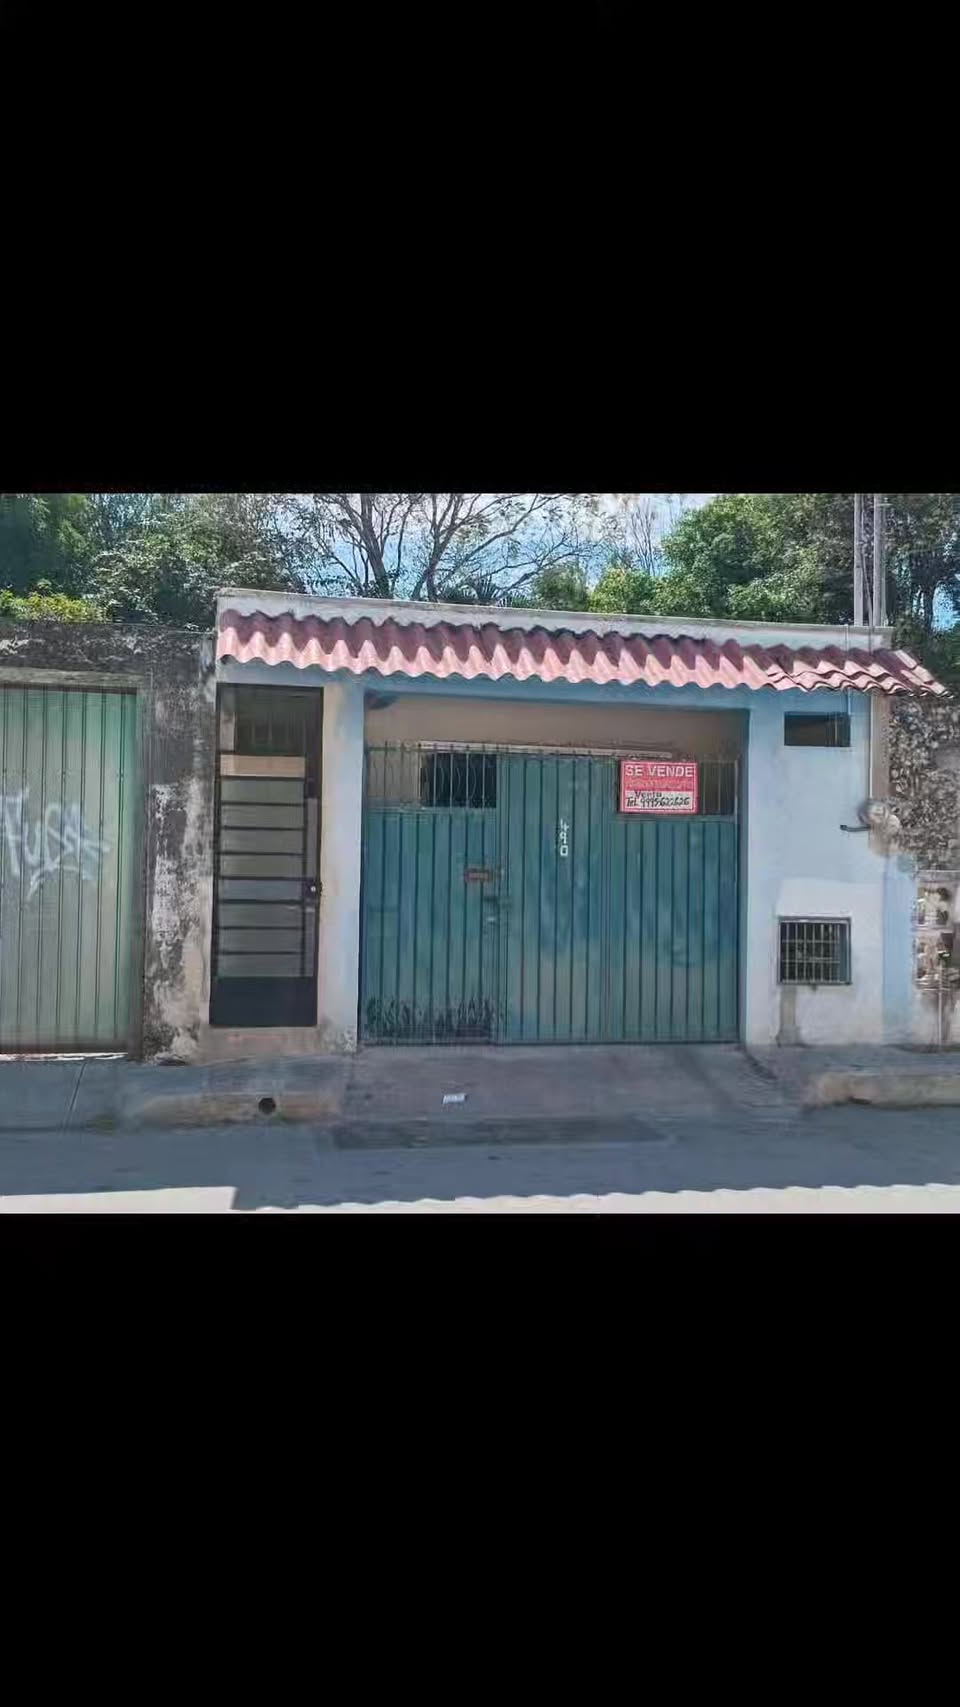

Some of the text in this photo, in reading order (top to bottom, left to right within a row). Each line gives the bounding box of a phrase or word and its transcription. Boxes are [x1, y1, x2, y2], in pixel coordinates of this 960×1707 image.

[625, 764, 695, 778] SE VENDE
[560, 818, 570, 857] 490
